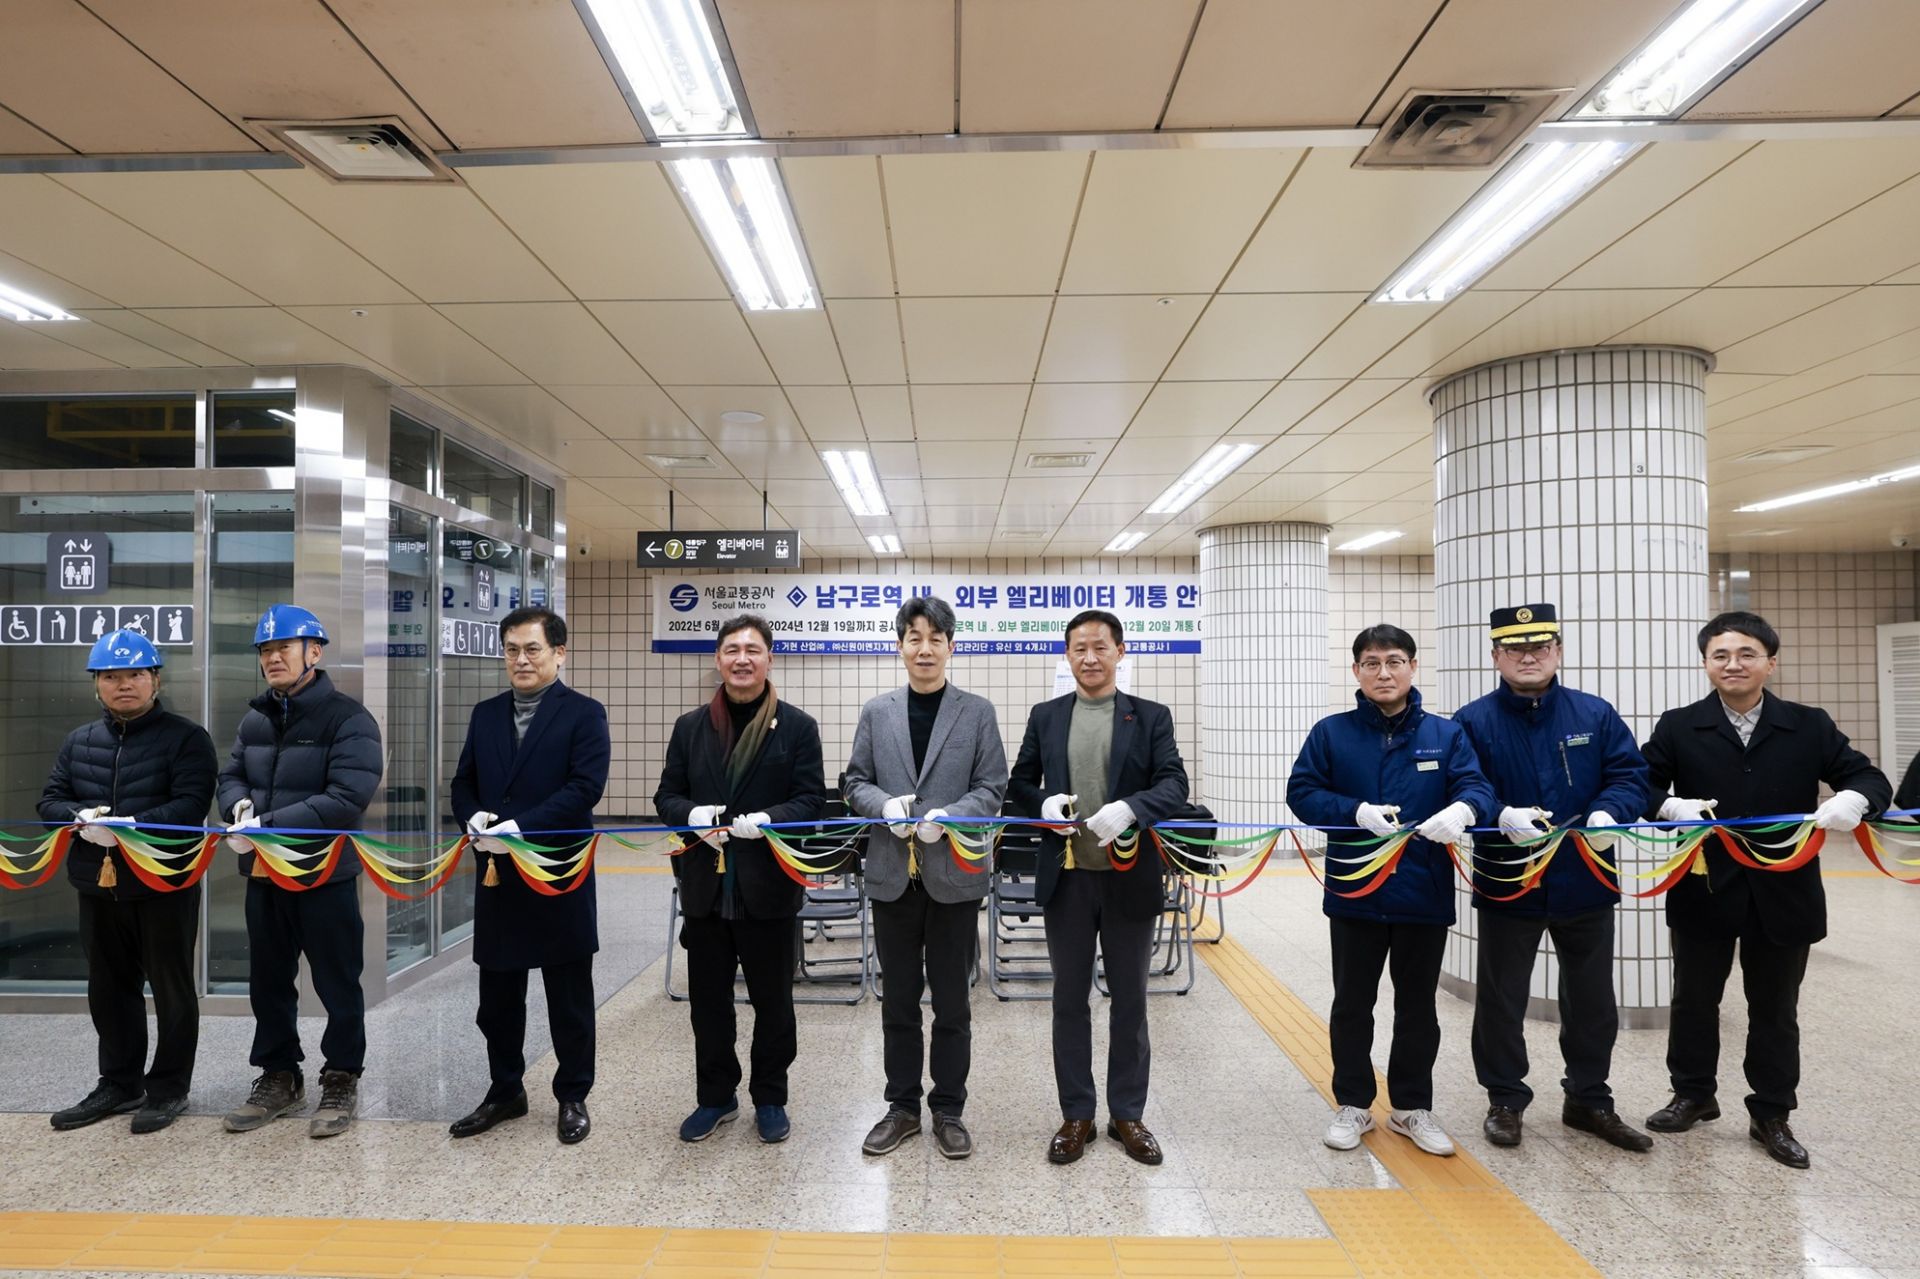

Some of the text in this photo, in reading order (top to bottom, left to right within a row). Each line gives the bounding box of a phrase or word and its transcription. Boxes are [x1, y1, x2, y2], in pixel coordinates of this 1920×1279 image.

[1636, 464, 1644, 474] 3
[670, 542, 679, 556] 7
[716, 538, 764, 552] 엘리베이터
[704, 586, 775, 600] 서울교통공사
[815, 585, 903, 609] 남구로역
[955, 586, 998, 609] 외부
[1007, 586, 1116, 609] 엘리베이터
[1125, 585, 1168, 609] 개통
[1176, 585, 1202, 609] 안
[712, 601, 766, 610] Seoul Metro
[668, 620, 702, 632] 2022년
[704, 620, 720, 632] 6월
[768, 620, 804, 633] 2024년
[807, 620, 830, 633] 12월
[833, 620, 876, 633] 19일까지
[977, 621, 987, 633] 내
[997, 621, 1018, 633] 외부
[1123, 620, 1145, 633] 12월
[1148, 620, 1171, 633] 20일
[1174, 620, 1194, 633] 개통
[955, 641, 989, 653] 업관리단
[995, 642, 1012, 652] 유신
[1014, 642, 1023, 652] 외
